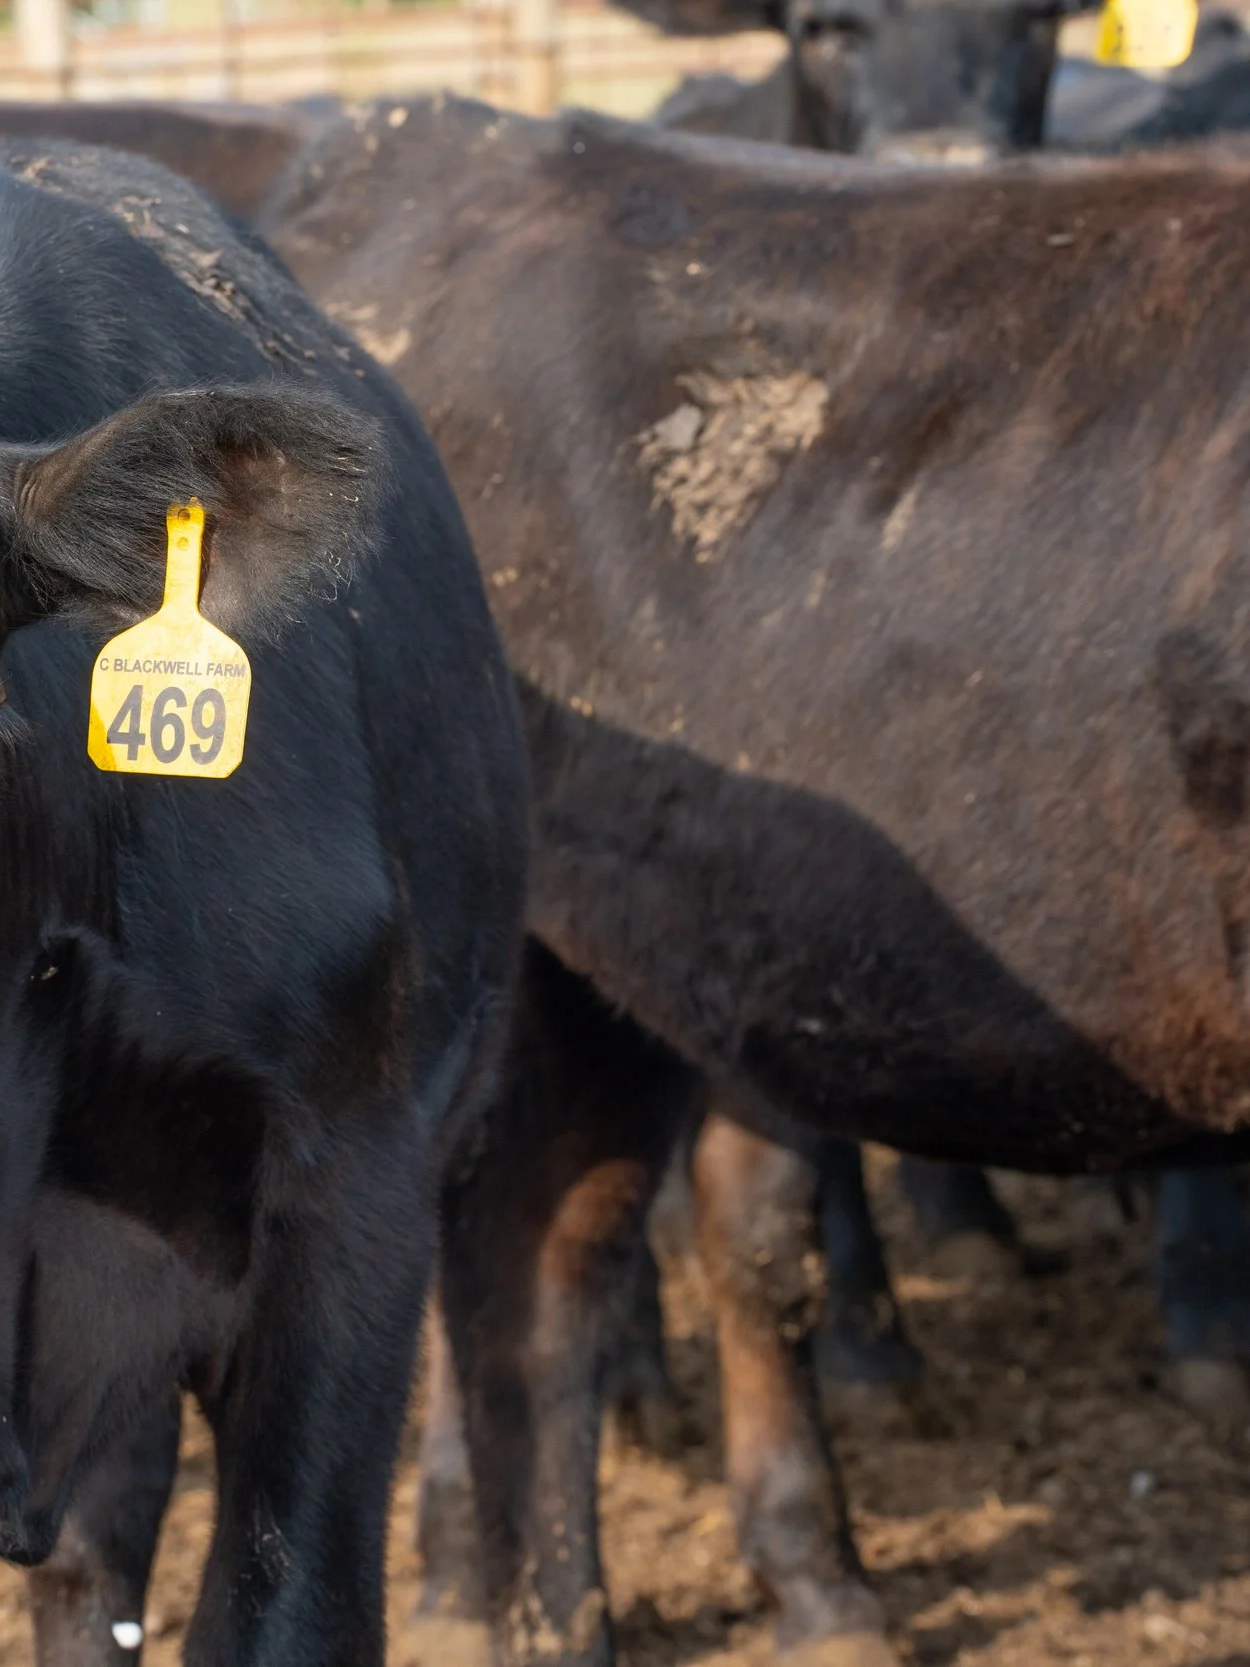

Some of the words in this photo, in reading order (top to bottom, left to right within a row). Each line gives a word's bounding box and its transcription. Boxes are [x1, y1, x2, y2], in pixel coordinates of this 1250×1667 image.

[100, 658, 109, 671] C
[114, 658, 202, 676] BLACKWELL
[206, 663, 245, 677] FARM
[107, 684, 226, 765] 469
